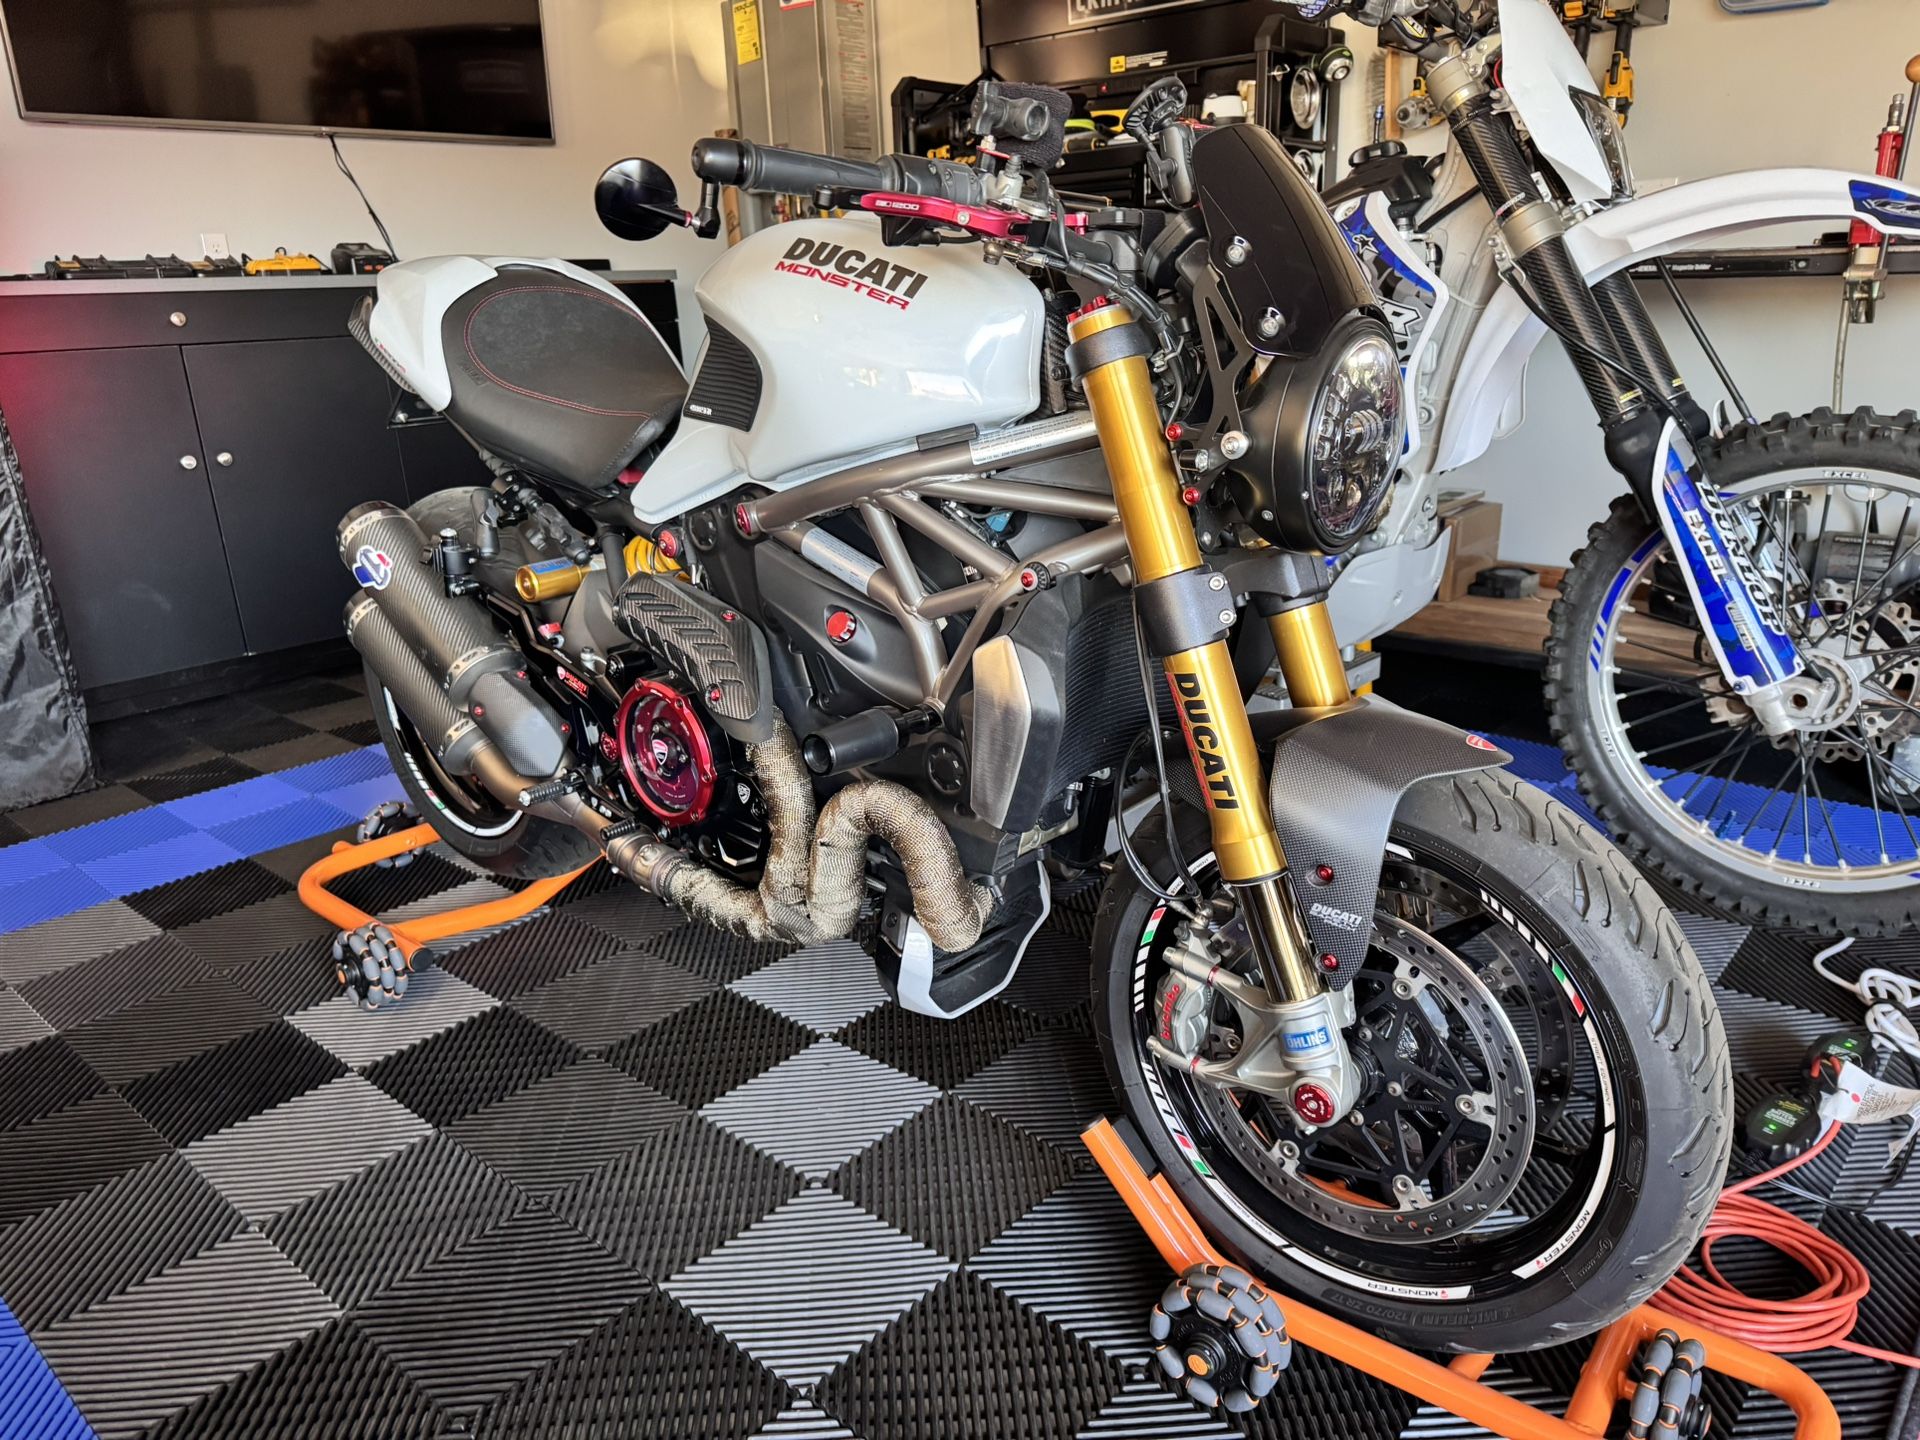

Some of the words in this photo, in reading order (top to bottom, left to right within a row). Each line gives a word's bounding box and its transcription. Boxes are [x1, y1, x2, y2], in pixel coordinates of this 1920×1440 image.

[774, 260, 911, 311] MONSTER
[782, 237, 929, 300] DUCATI
[1823, 470, 1868, 480] EXCEL
[1684, 509, 1728, 580] EXCEL
[1695, 481, 1786, 636] DUNLOP
[1174, 672, 1239, 810] DUCATI
[1310, 902, 1363, 926] DUCATI
[1159, 983, 1180, 1041] brembo
[1591, 1037, 1604, 1065] STREET
[1543, 1209, 1591, 1263] MONSTER
[1366, 1304, 1407, 1321] 120/70
[1367, 1282, 1438, 1297] MONSTER
[1422, 1309, 1497, 1325] MICHELIN
